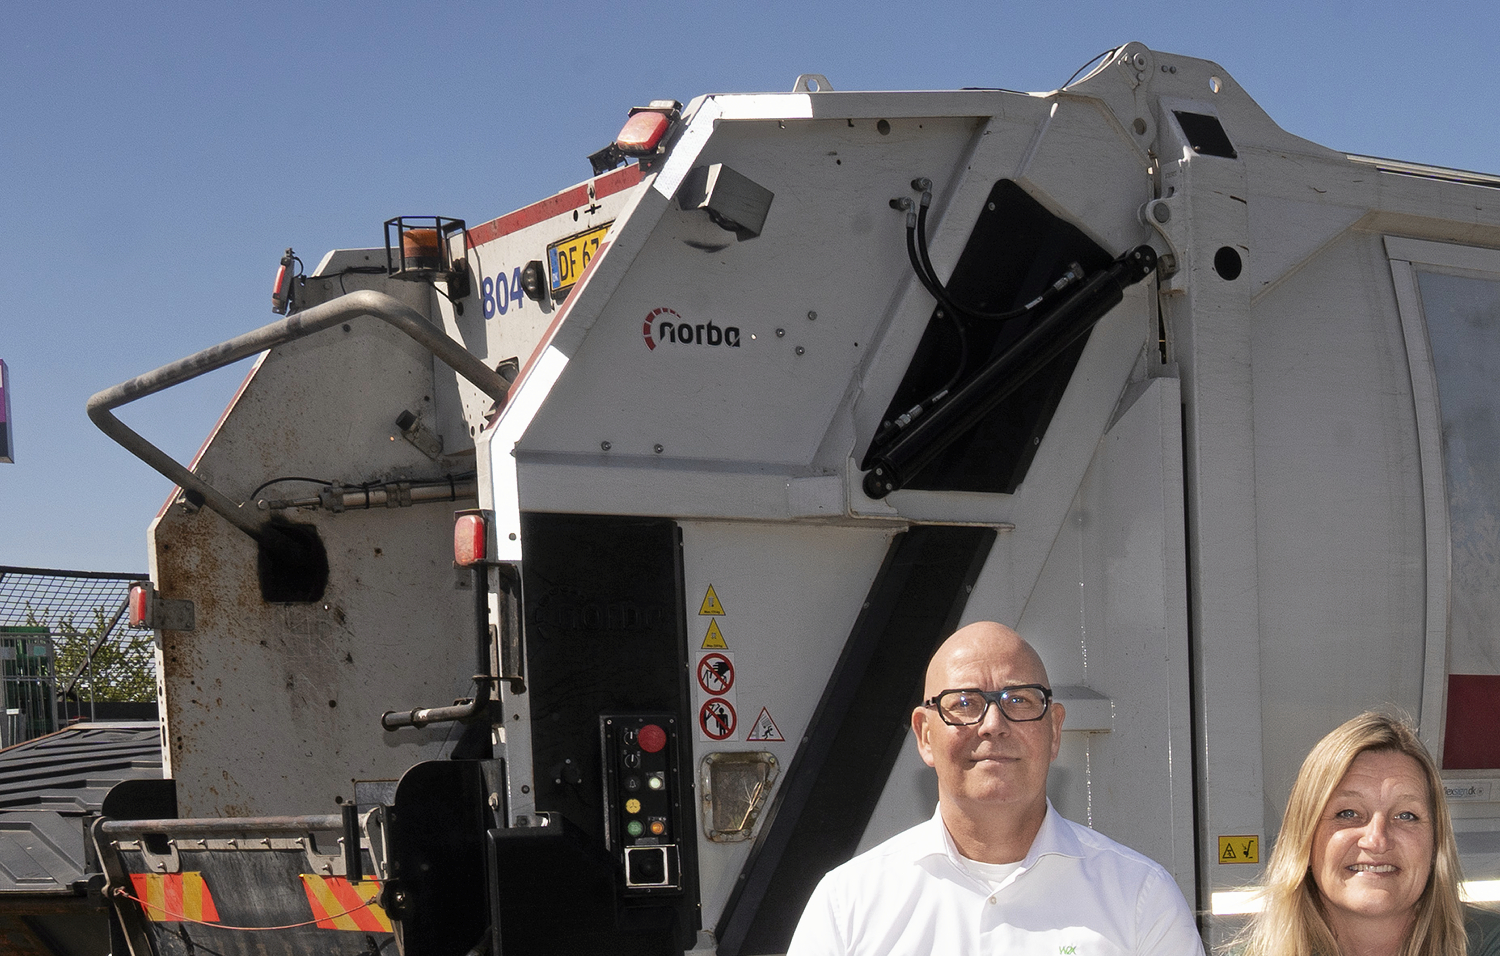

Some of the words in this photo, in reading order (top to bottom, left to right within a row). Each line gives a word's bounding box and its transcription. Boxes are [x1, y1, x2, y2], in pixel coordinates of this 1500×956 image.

[558, 245, 577, 282] DF
[482, 266, 525, 320] 804
[658, 319, 741, 348] norba
